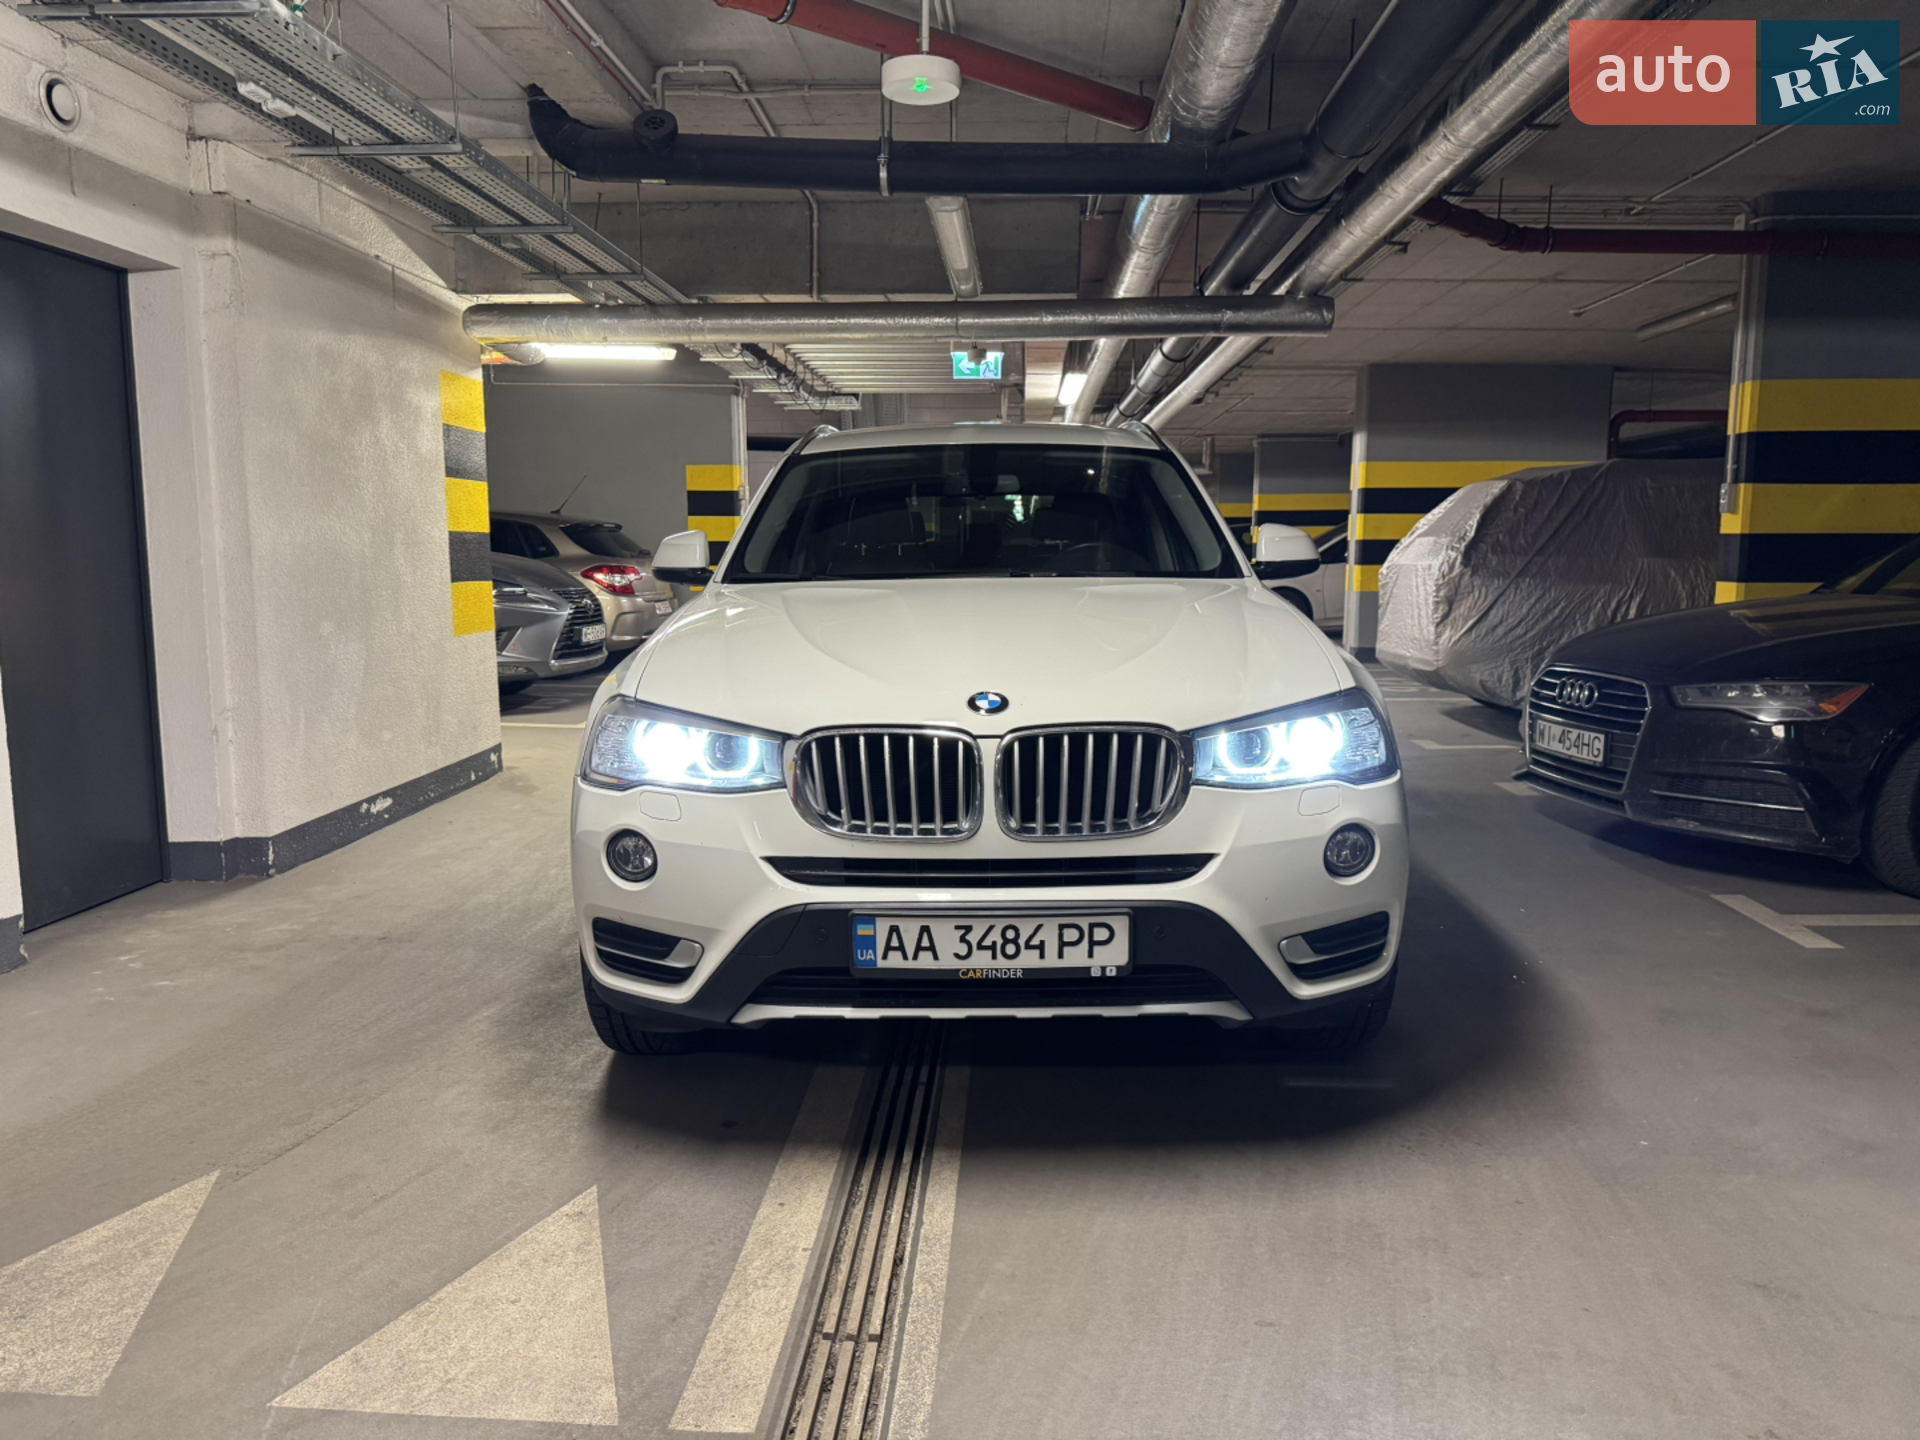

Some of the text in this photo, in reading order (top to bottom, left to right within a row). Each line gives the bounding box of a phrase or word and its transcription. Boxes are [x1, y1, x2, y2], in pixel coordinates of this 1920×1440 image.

[1558, 728, 1602, 758] 454HG
[881, 922, 1116, 961] AA 3484 PP
[857, 949, 875, 961] UA
[958, 968, 1023, 979] CARFINDER
